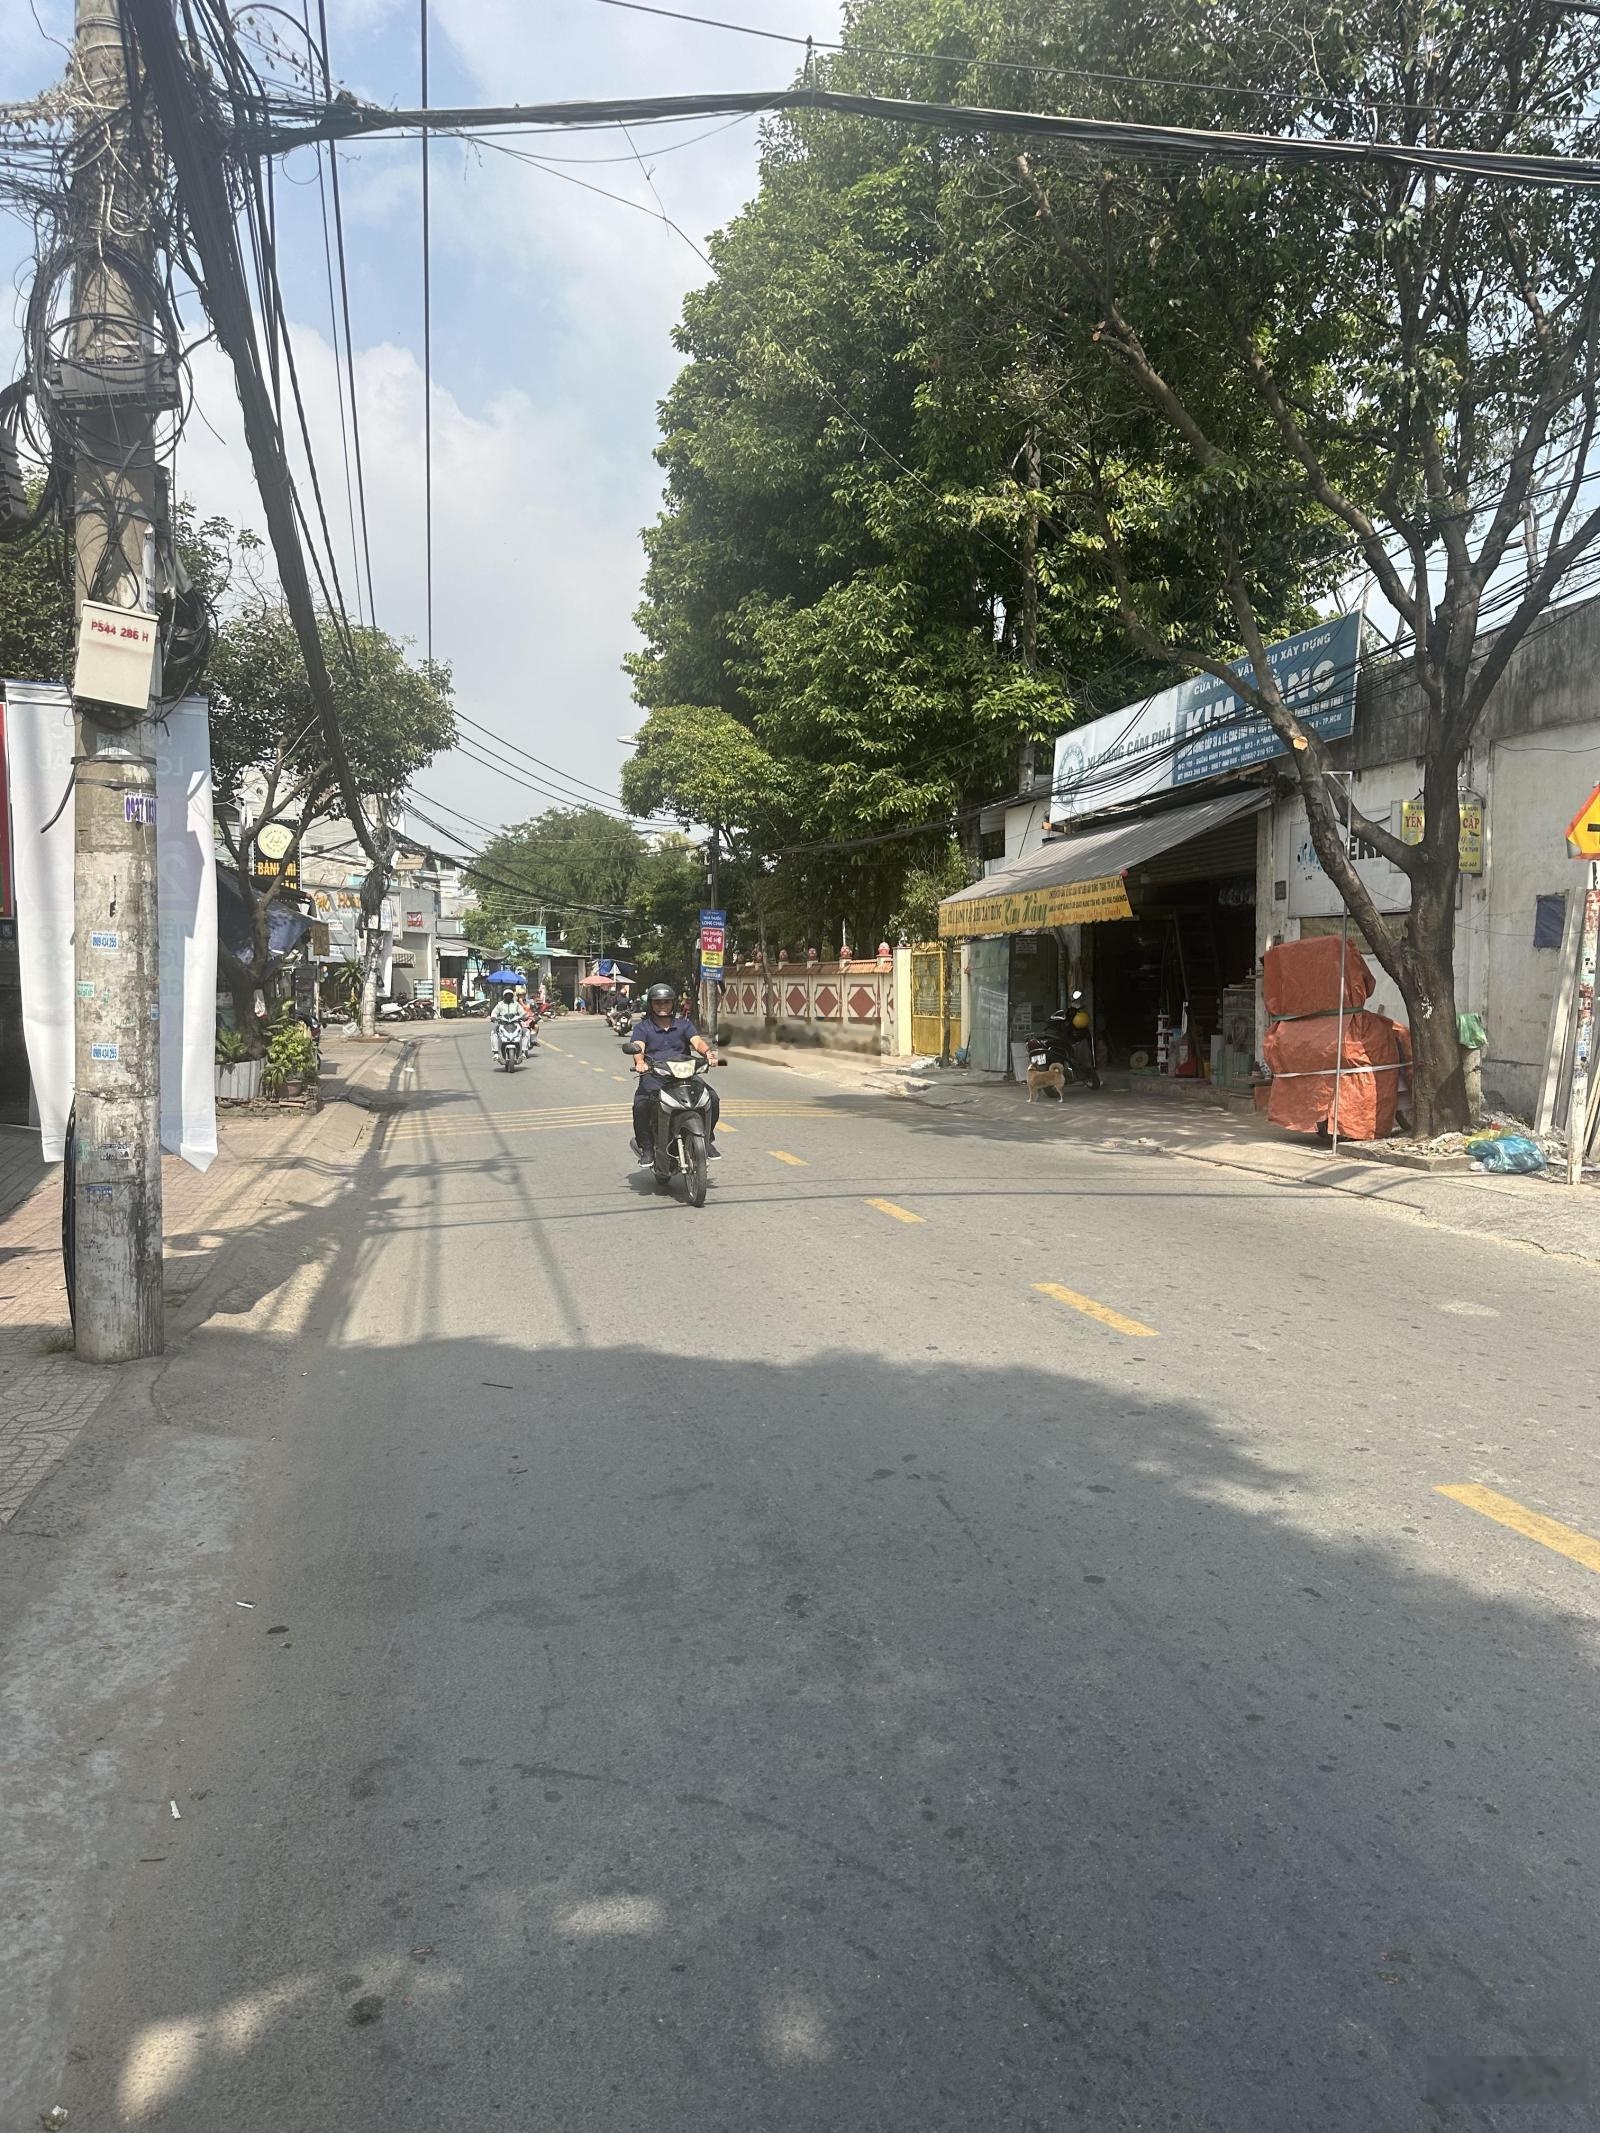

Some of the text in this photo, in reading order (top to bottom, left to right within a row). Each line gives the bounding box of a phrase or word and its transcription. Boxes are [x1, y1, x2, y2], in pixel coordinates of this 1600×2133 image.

[91, 621, 149, 642] P544 286 H
[1280, 646, 1300, 661] XÂY
[1301, 632, 1331, 652] DỰNG
[1185, 695, 1237, 739] KIM
[1152, 721, 1172, 749] PHẢ
[1405, 811, 1423, 828] YẾN
[1462, 812, 1480, 829] CẤP
